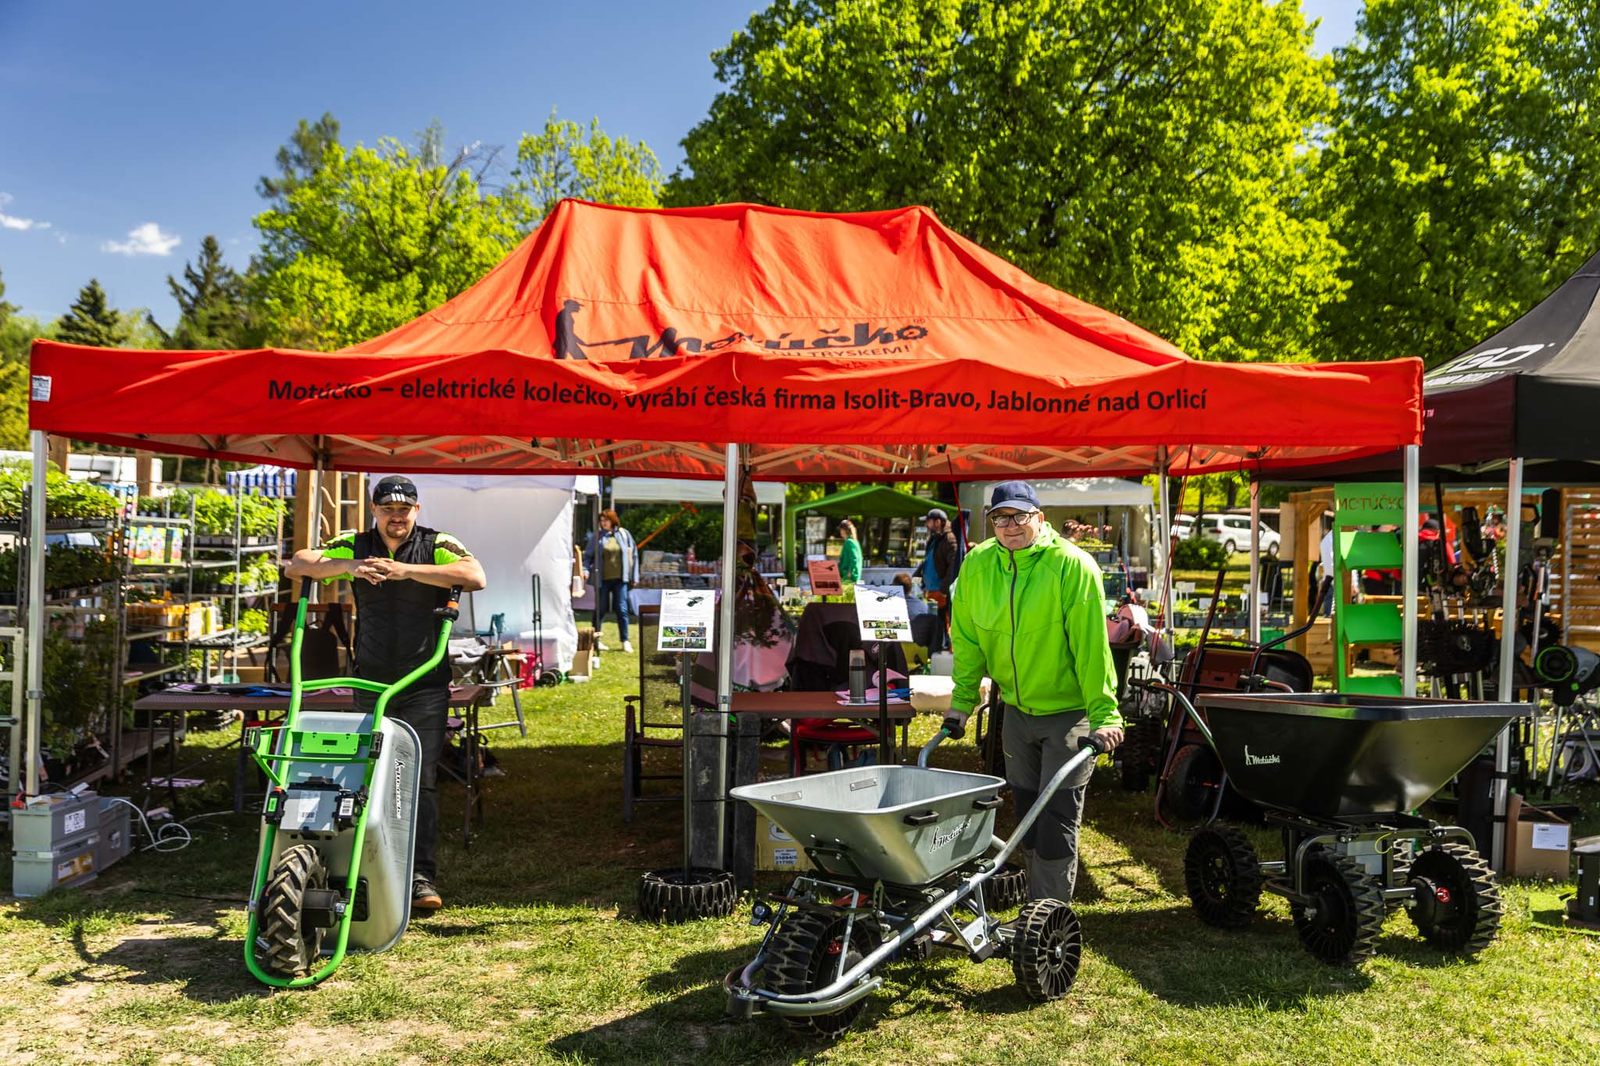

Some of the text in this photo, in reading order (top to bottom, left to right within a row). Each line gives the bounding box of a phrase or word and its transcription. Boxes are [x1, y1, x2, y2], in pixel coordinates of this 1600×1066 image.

[268, 380, 372, 401] Motúčko
[400, 378, 516, 399] elektrické
[523, 380, 619, 410] kolečko,
[625, 385, 698, 412] vyrábí
[703, 385, 767, 408] česká
[773, 388, 836, 409] firma
[844, 389, 981, 411] Isolit-Bravo,
[987, 390, 1091, 412] Jablonné
[1097, 391, 1140, 411] nad
[1147, 388, 1208, 410] Orlicí
